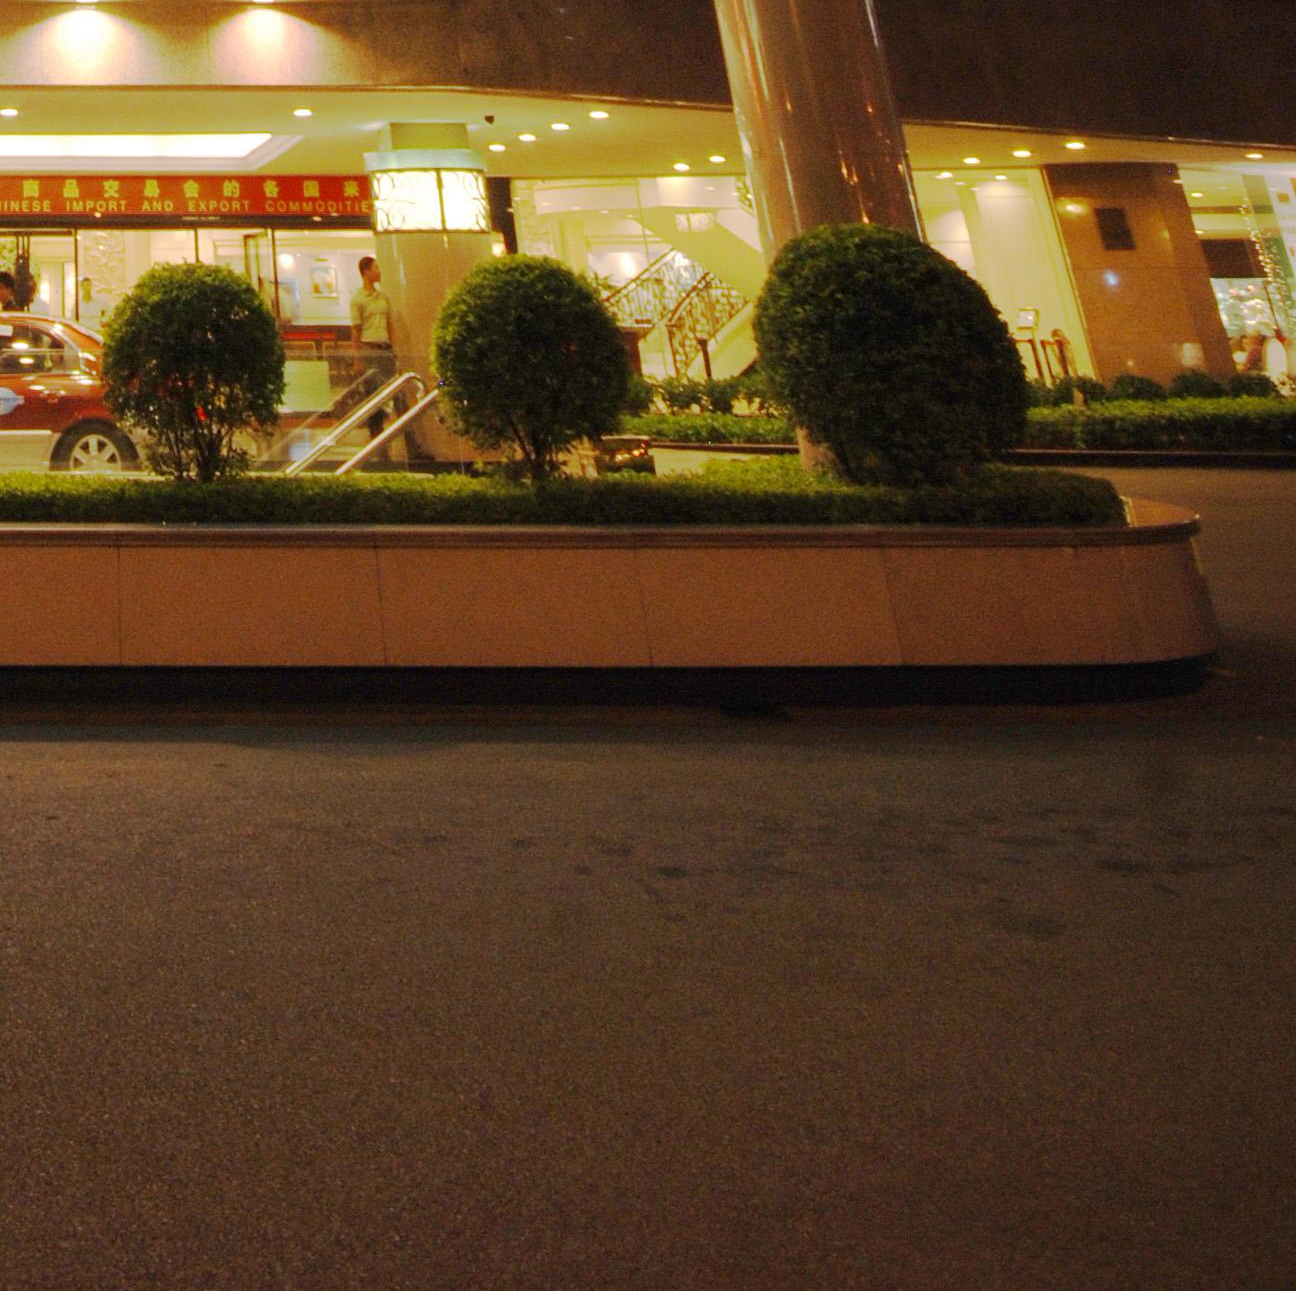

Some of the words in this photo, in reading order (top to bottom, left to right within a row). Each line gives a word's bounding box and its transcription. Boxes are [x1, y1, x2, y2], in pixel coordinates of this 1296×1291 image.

[66, 200, 128, 212] IMPORT
[141, 200, 174, 212] AND
[188, 200, 251, 212] EXPORT
[265, 200, 369, 212] COMMODITIE
